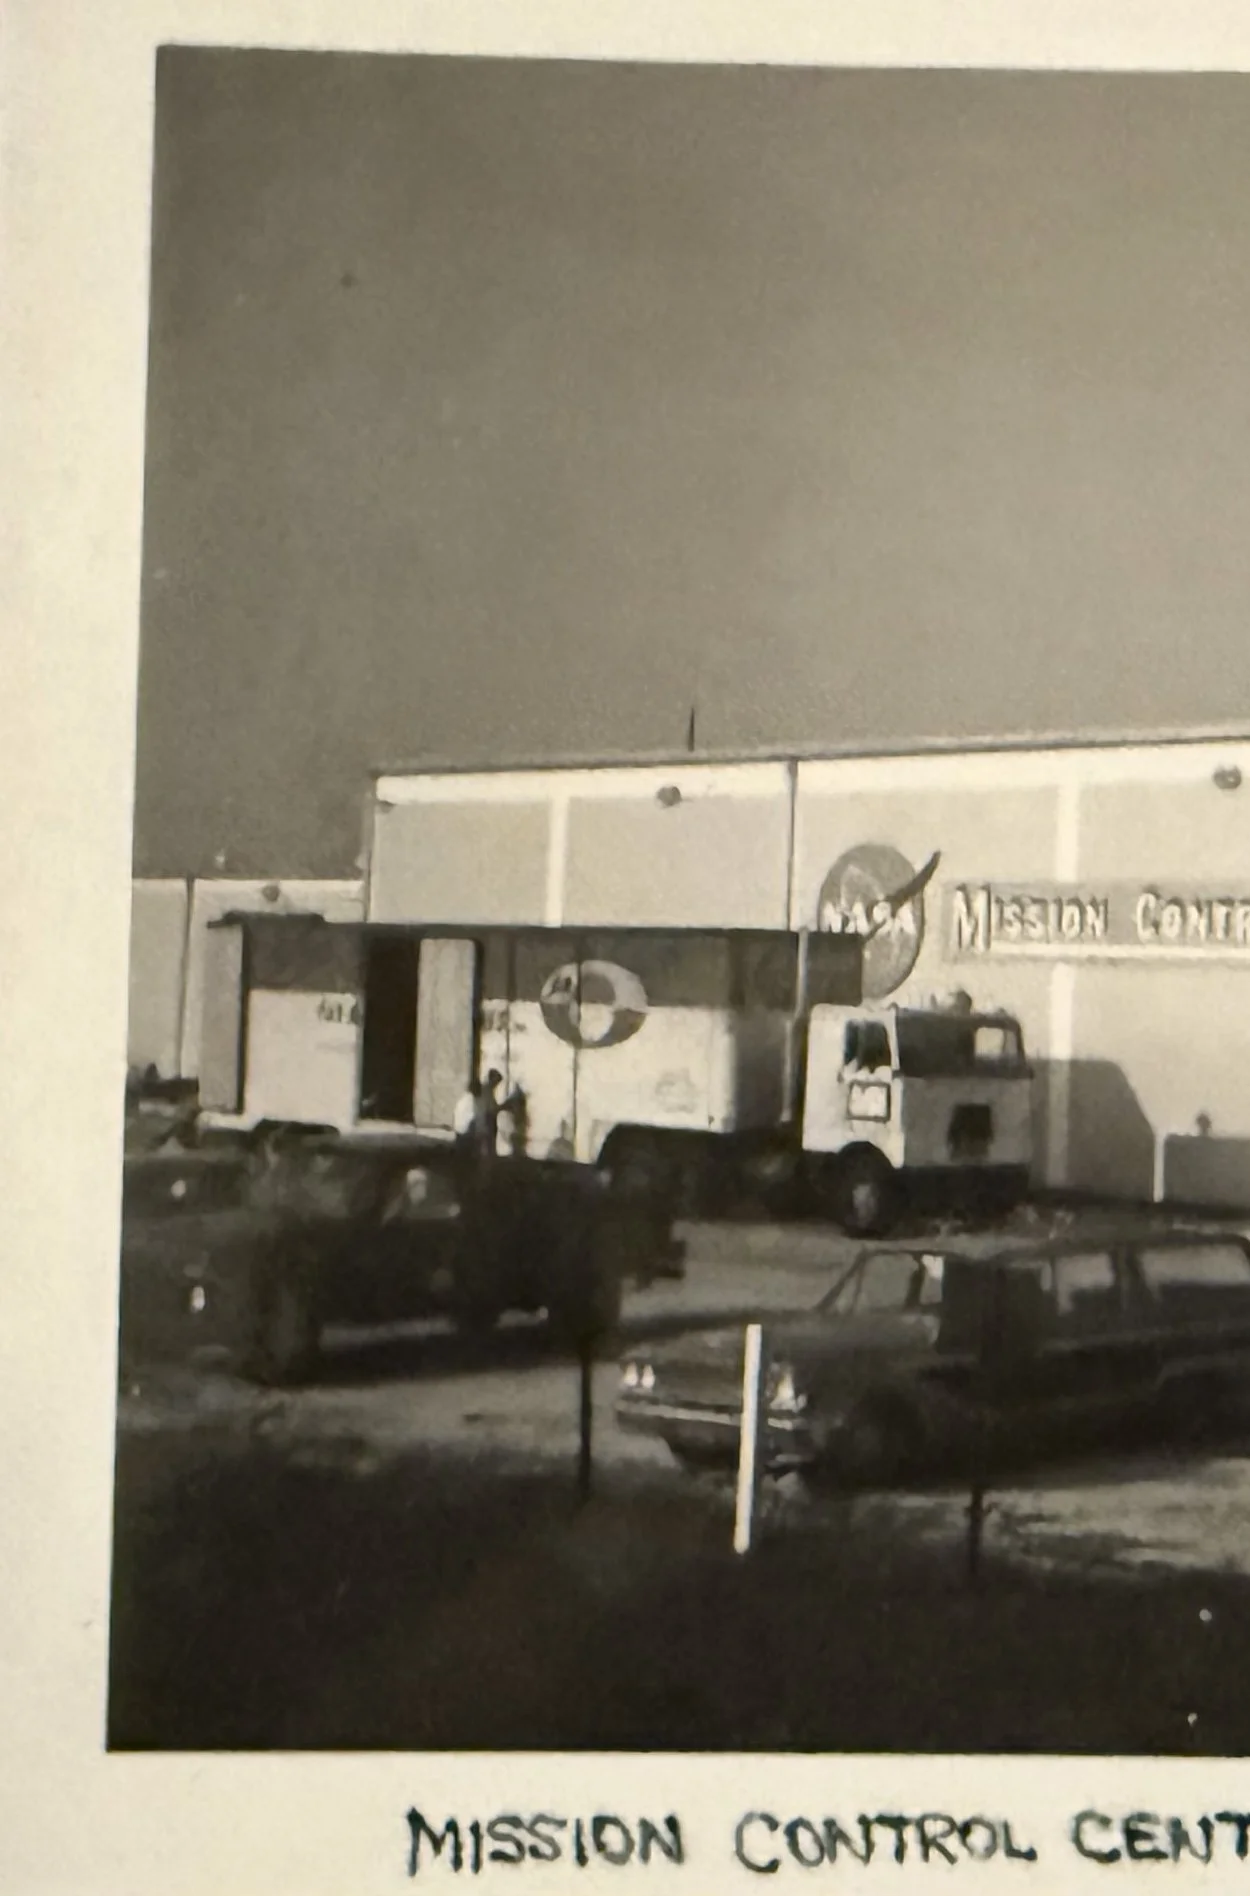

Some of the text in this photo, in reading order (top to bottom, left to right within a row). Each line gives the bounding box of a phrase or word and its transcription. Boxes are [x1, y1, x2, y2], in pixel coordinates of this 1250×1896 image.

[819, 899, 918, 934] NASA
[955, 884, 1108, 950] MISSION
[406, 1806, 687, 1876] MISSION
[734, 1810, 1038, 1873] CONTROL
